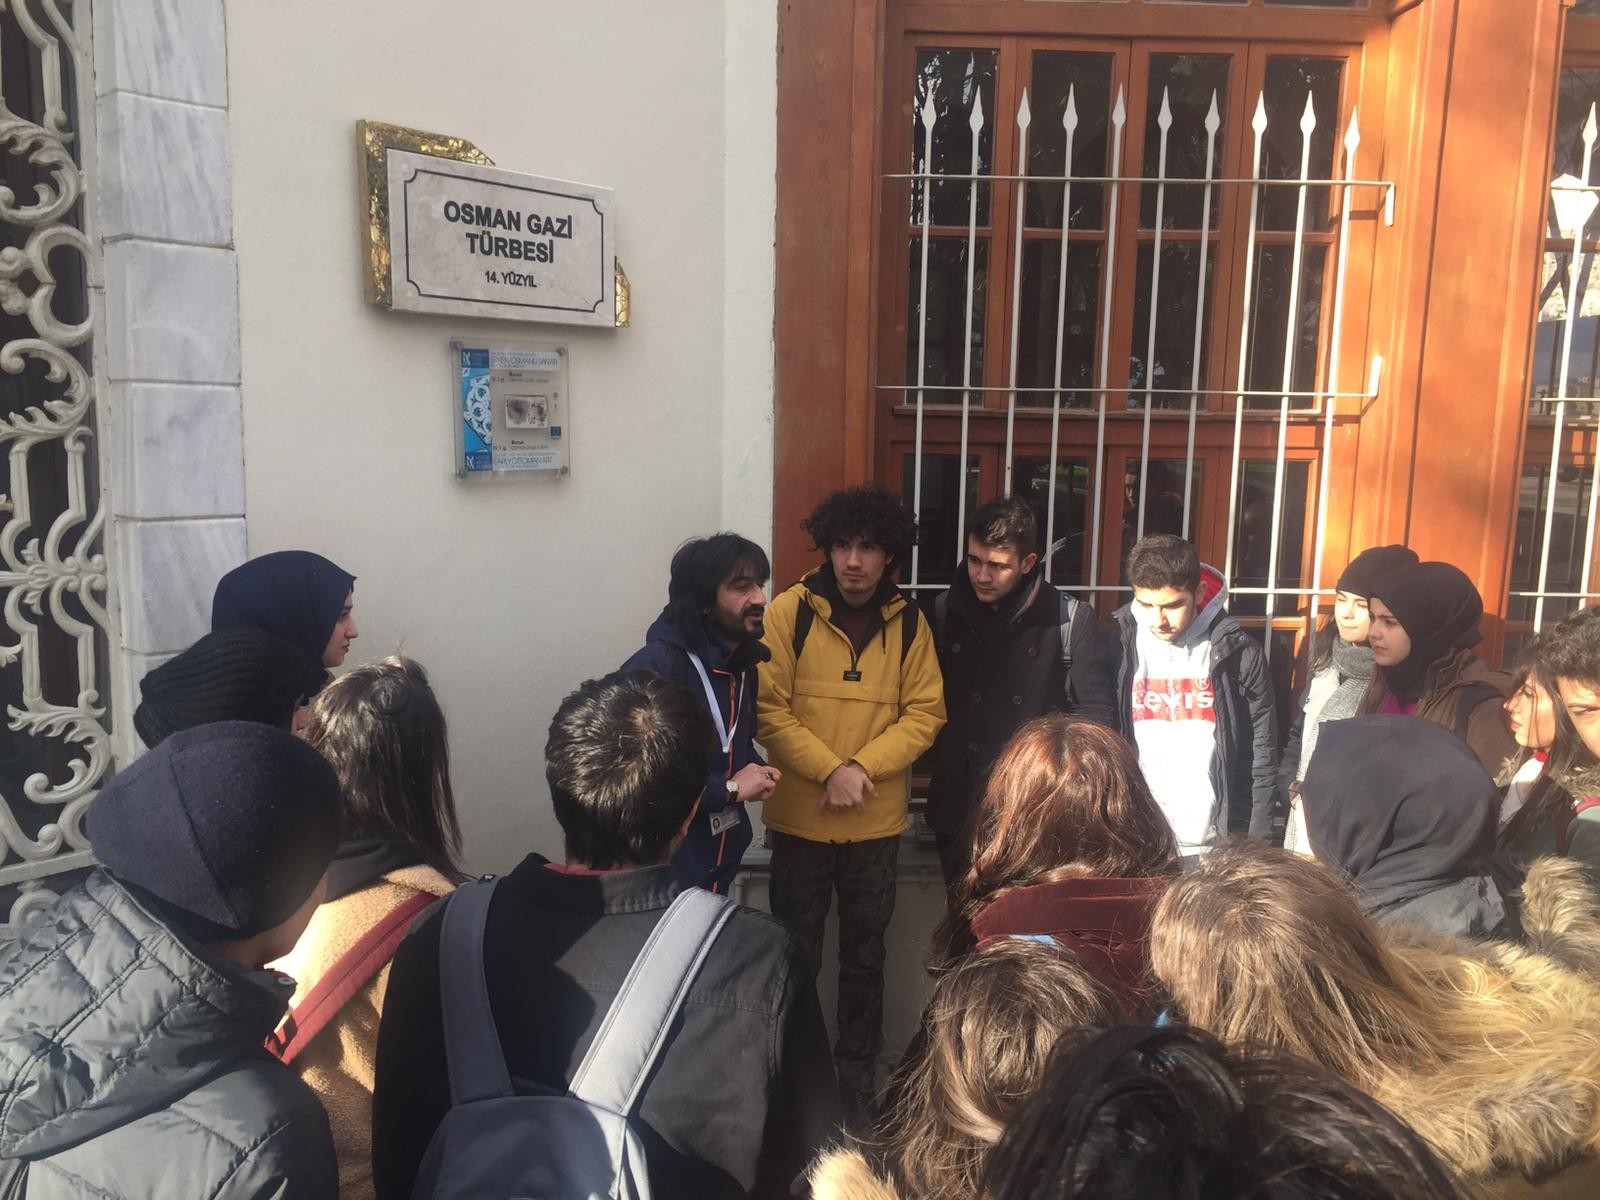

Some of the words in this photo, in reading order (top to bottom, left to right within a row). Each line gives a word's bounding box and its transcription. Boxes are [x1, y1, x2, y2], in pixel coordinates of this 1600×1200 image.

[443, 200, 521, 231] OSMAN
[527, 214, 572, 239] GAZİ
[465, 230, 554, 264] TÜRBESİ
[485, 270, 499, 284] 14.
[502, 272, 537, 287] YÜZYIL
